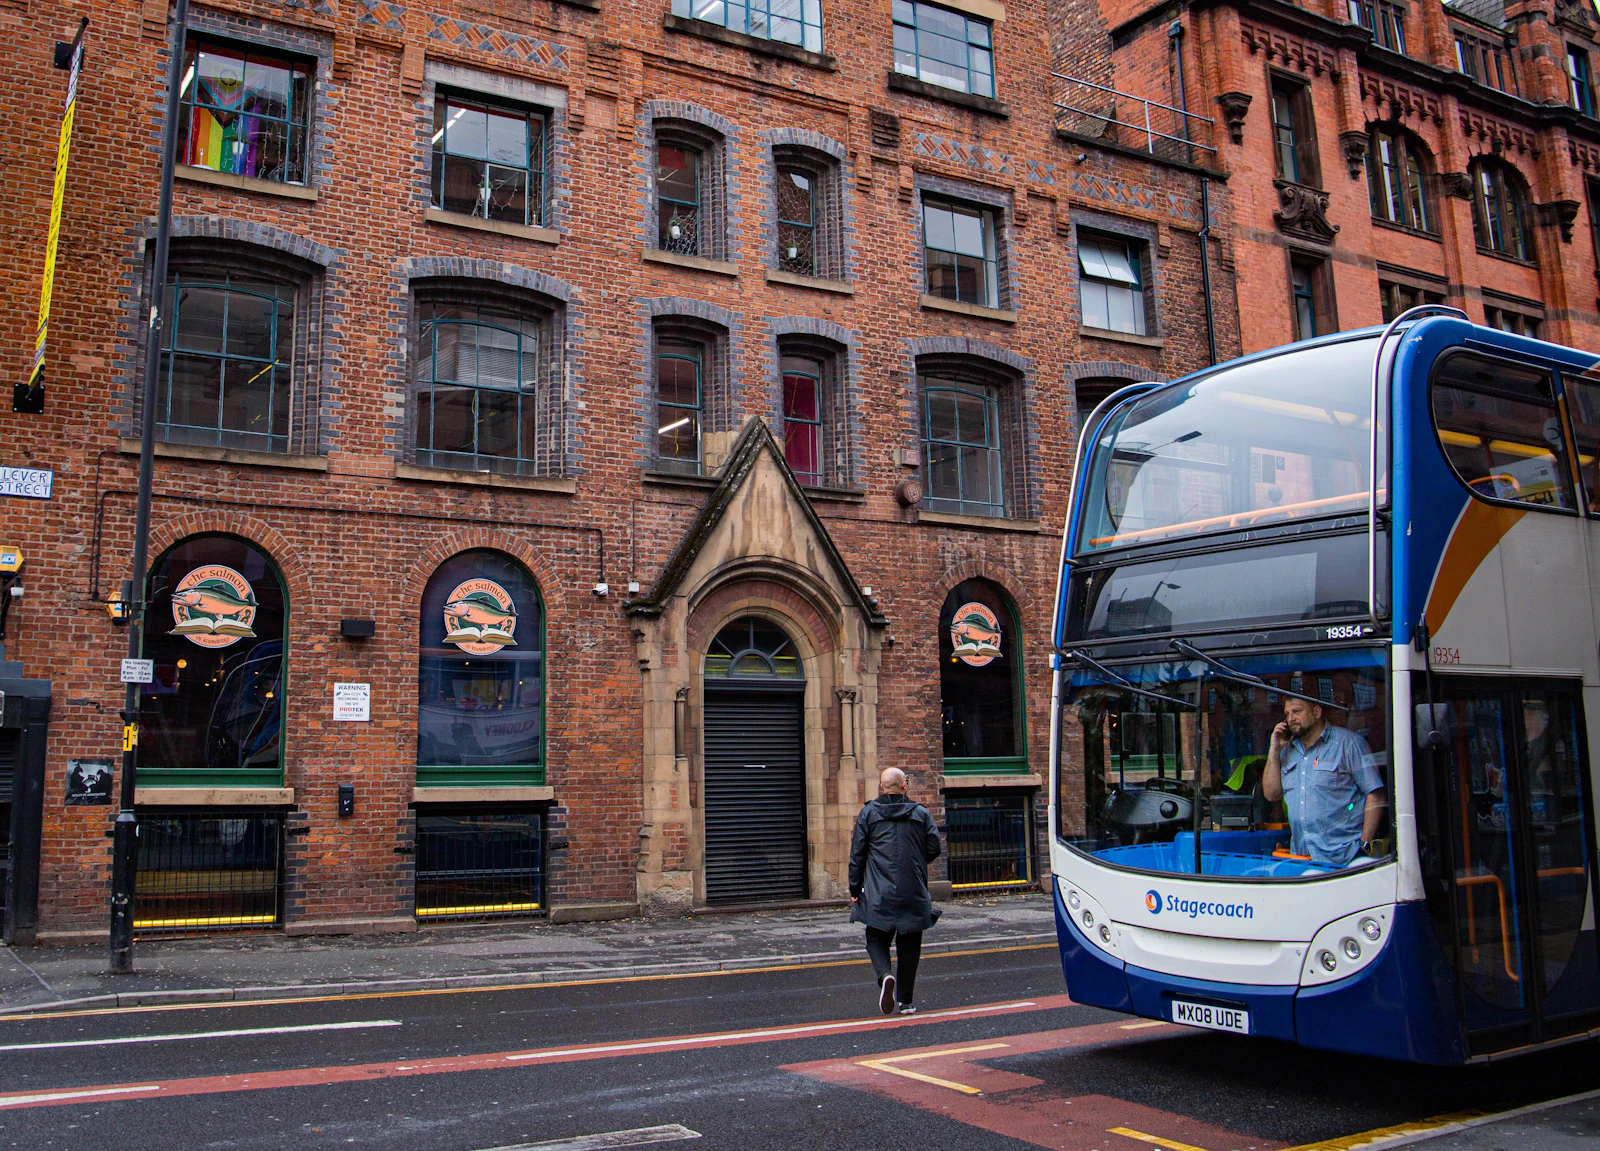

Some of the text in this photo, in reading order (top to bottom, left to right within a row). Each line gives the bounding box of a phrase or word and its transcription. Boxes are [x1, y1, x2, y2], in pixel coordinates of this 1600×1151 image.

[3, 469, 47, 483] LEVER
[2, 555, 17, 563] ADT
[209, 569, 246, 592] salmon
[475, 582, 507, 604] salmon
[1325, 625, 1362, 639] 19354
[1433, 647, 1460, 664] 19354
[1166, 894, 1254, 919] Stagecoach
[1177, 1003, 1243, 1029] MX08 UDE
